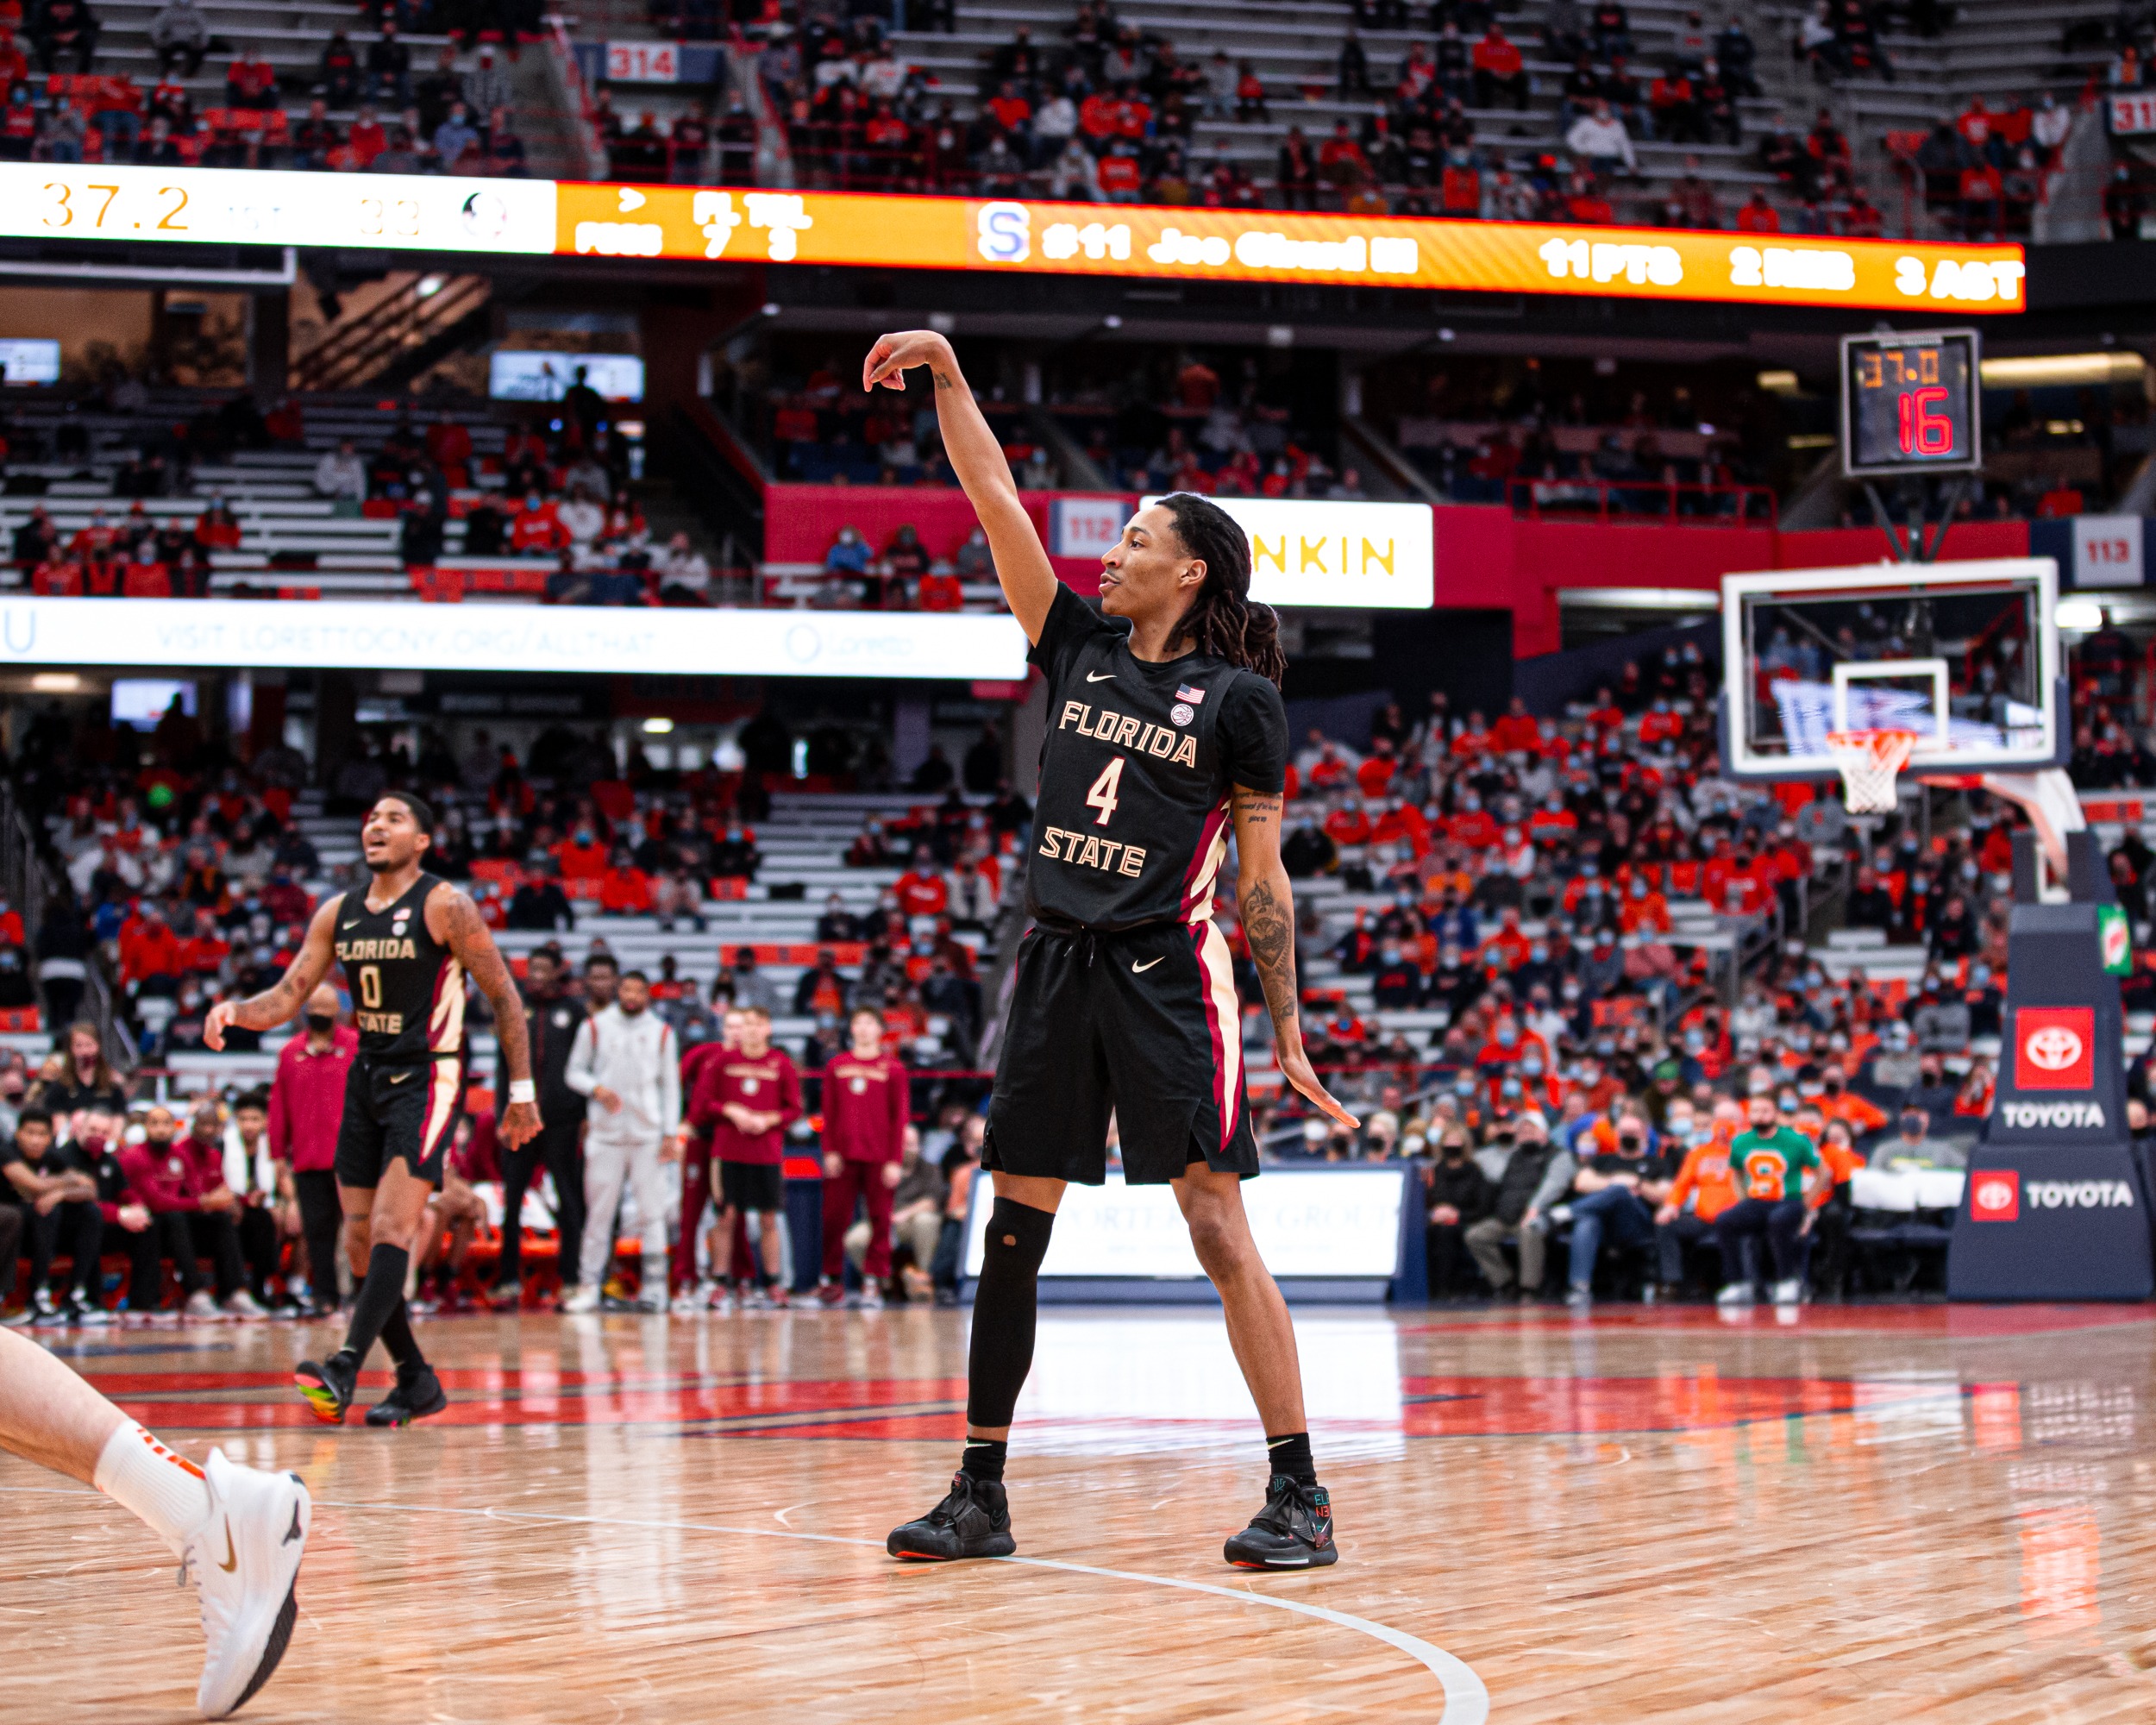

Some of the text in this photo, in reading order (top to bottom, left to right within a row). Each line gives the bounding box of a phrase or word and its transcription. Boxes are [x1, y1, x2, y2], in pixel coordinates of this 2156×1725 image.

[611, 47, 674, 80] 314
[2115, 101, 2156, 131] 31
[41, 182, 191, 231] 37.2
[1863, 349, 1940, 388] 37.0
[1899, 386, 1953, 455] 16
[1071, 517, 1114, 542] 112
[1253, 533, 1395, 576] NKIN
[2087, 539, 2129, 563] 113
[1058, 700, 1198, 768] FLORIDA
[1085, 756, 1126, 827] 4
[1038, 825, 1147, 878] STATE
[359, 964, 383, 1009] 0
[2001, 1101, 2106, 1128] TOYOTA
[2027, 1180, 2134, 1209] TOYOTA
